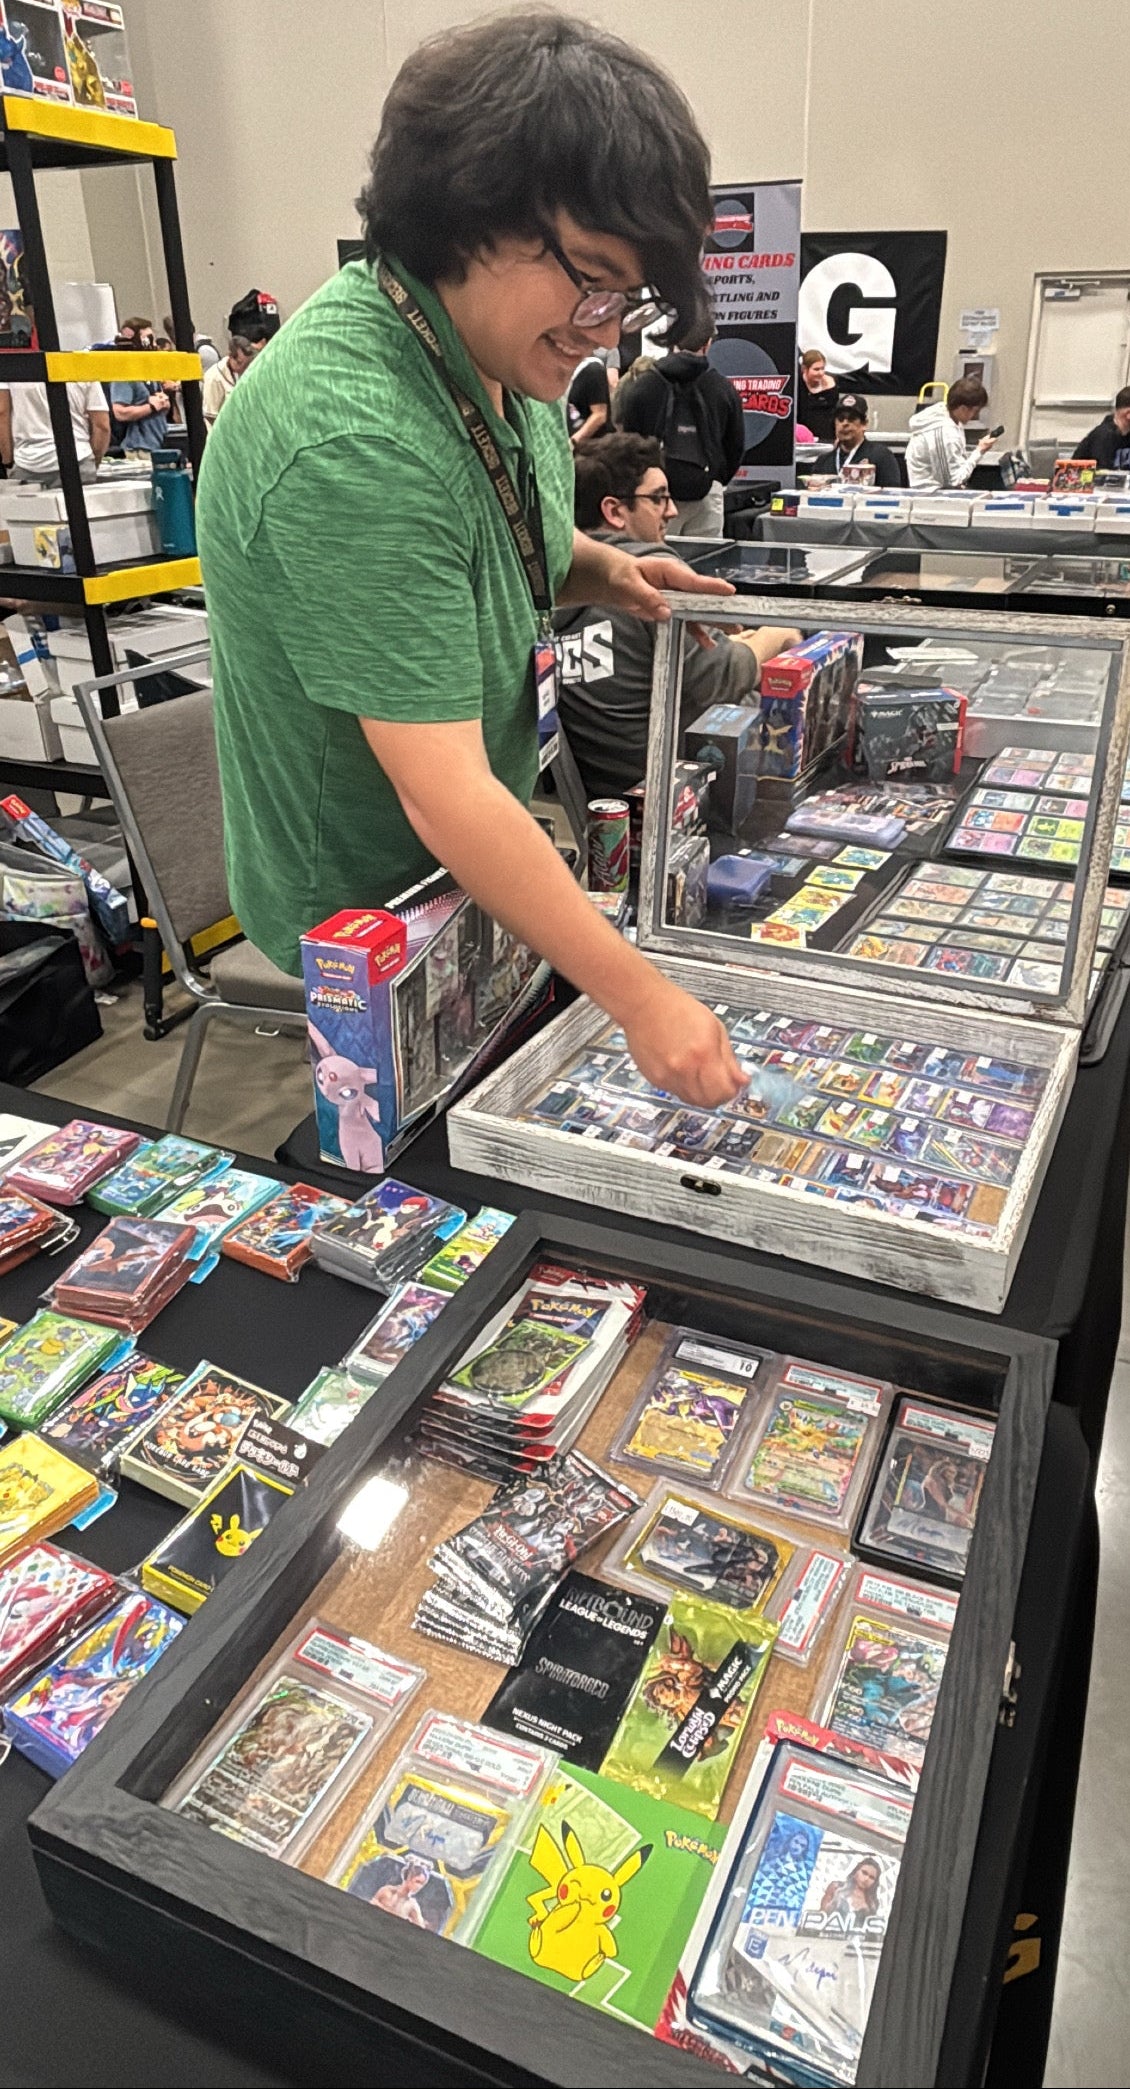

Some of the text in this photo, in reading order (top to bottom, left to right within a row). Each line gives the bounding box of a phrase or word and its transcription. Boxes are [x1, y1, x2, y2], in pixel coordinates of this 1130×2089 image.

[703, 252, 796, 270] ING CARDS
[713, 273, 756, 285] PORTS,
[714, 291, 780, 304] TLING AND
[727, 309, 779, 321] FIGURES
[797, 252, 897, 374] G
[406, 308, 442, 357] ECKETT
[732, 379, 782, 391] ING TRADING
[384, 884, 426, 910] PREMIUM
[310, 991, 368, 1011] PRISMATIC
[739, 1361, 753, 1373] 10
[558, 1598, 599, 1623] LEAGUE
[602, 1617, 649, 1641] LEGENDS
[534, 1656, 610, 1699] SPIRITFORGED
[716, 1656, 743, 1692] MAGIC
[511, 1706, 584, 1744] NEXUS NIGHT PACK
[750, 1907, 888, 1935] PEN PALS
